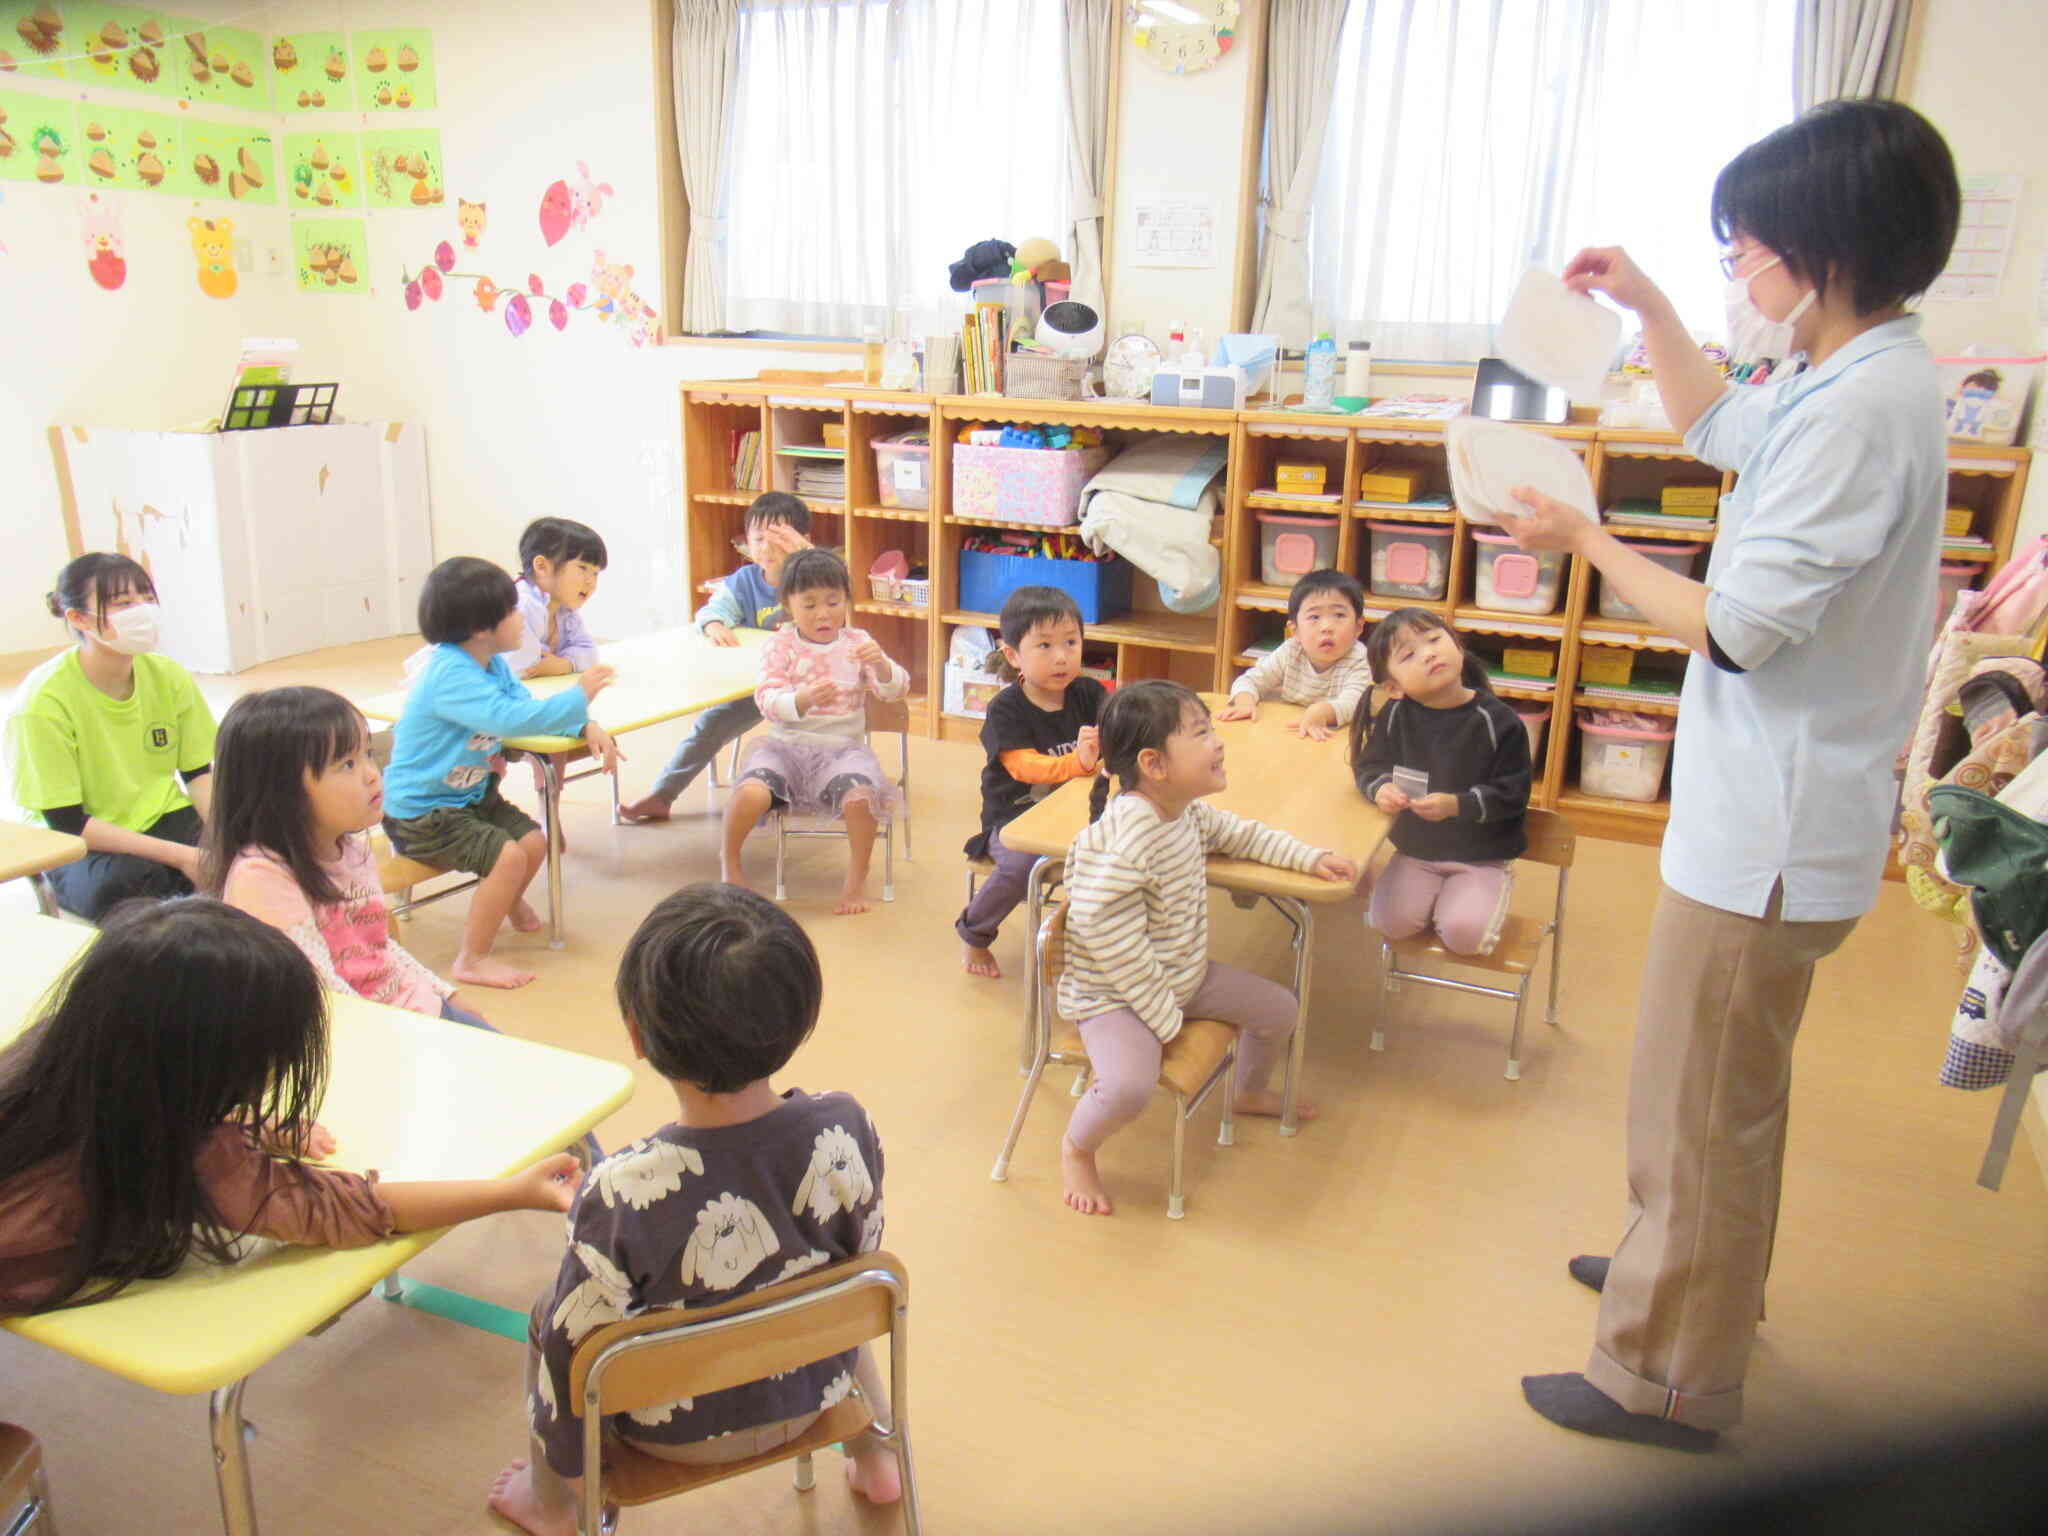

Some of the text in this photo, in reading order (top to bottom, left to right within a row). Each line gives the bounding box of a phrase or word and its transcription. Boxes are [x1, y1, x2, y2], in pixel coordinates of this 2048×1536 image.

[1216, 2, 1225, 16] 3
[1160, 41, 1169, 54] 7
[1198, 39, 1209, 55] 5
